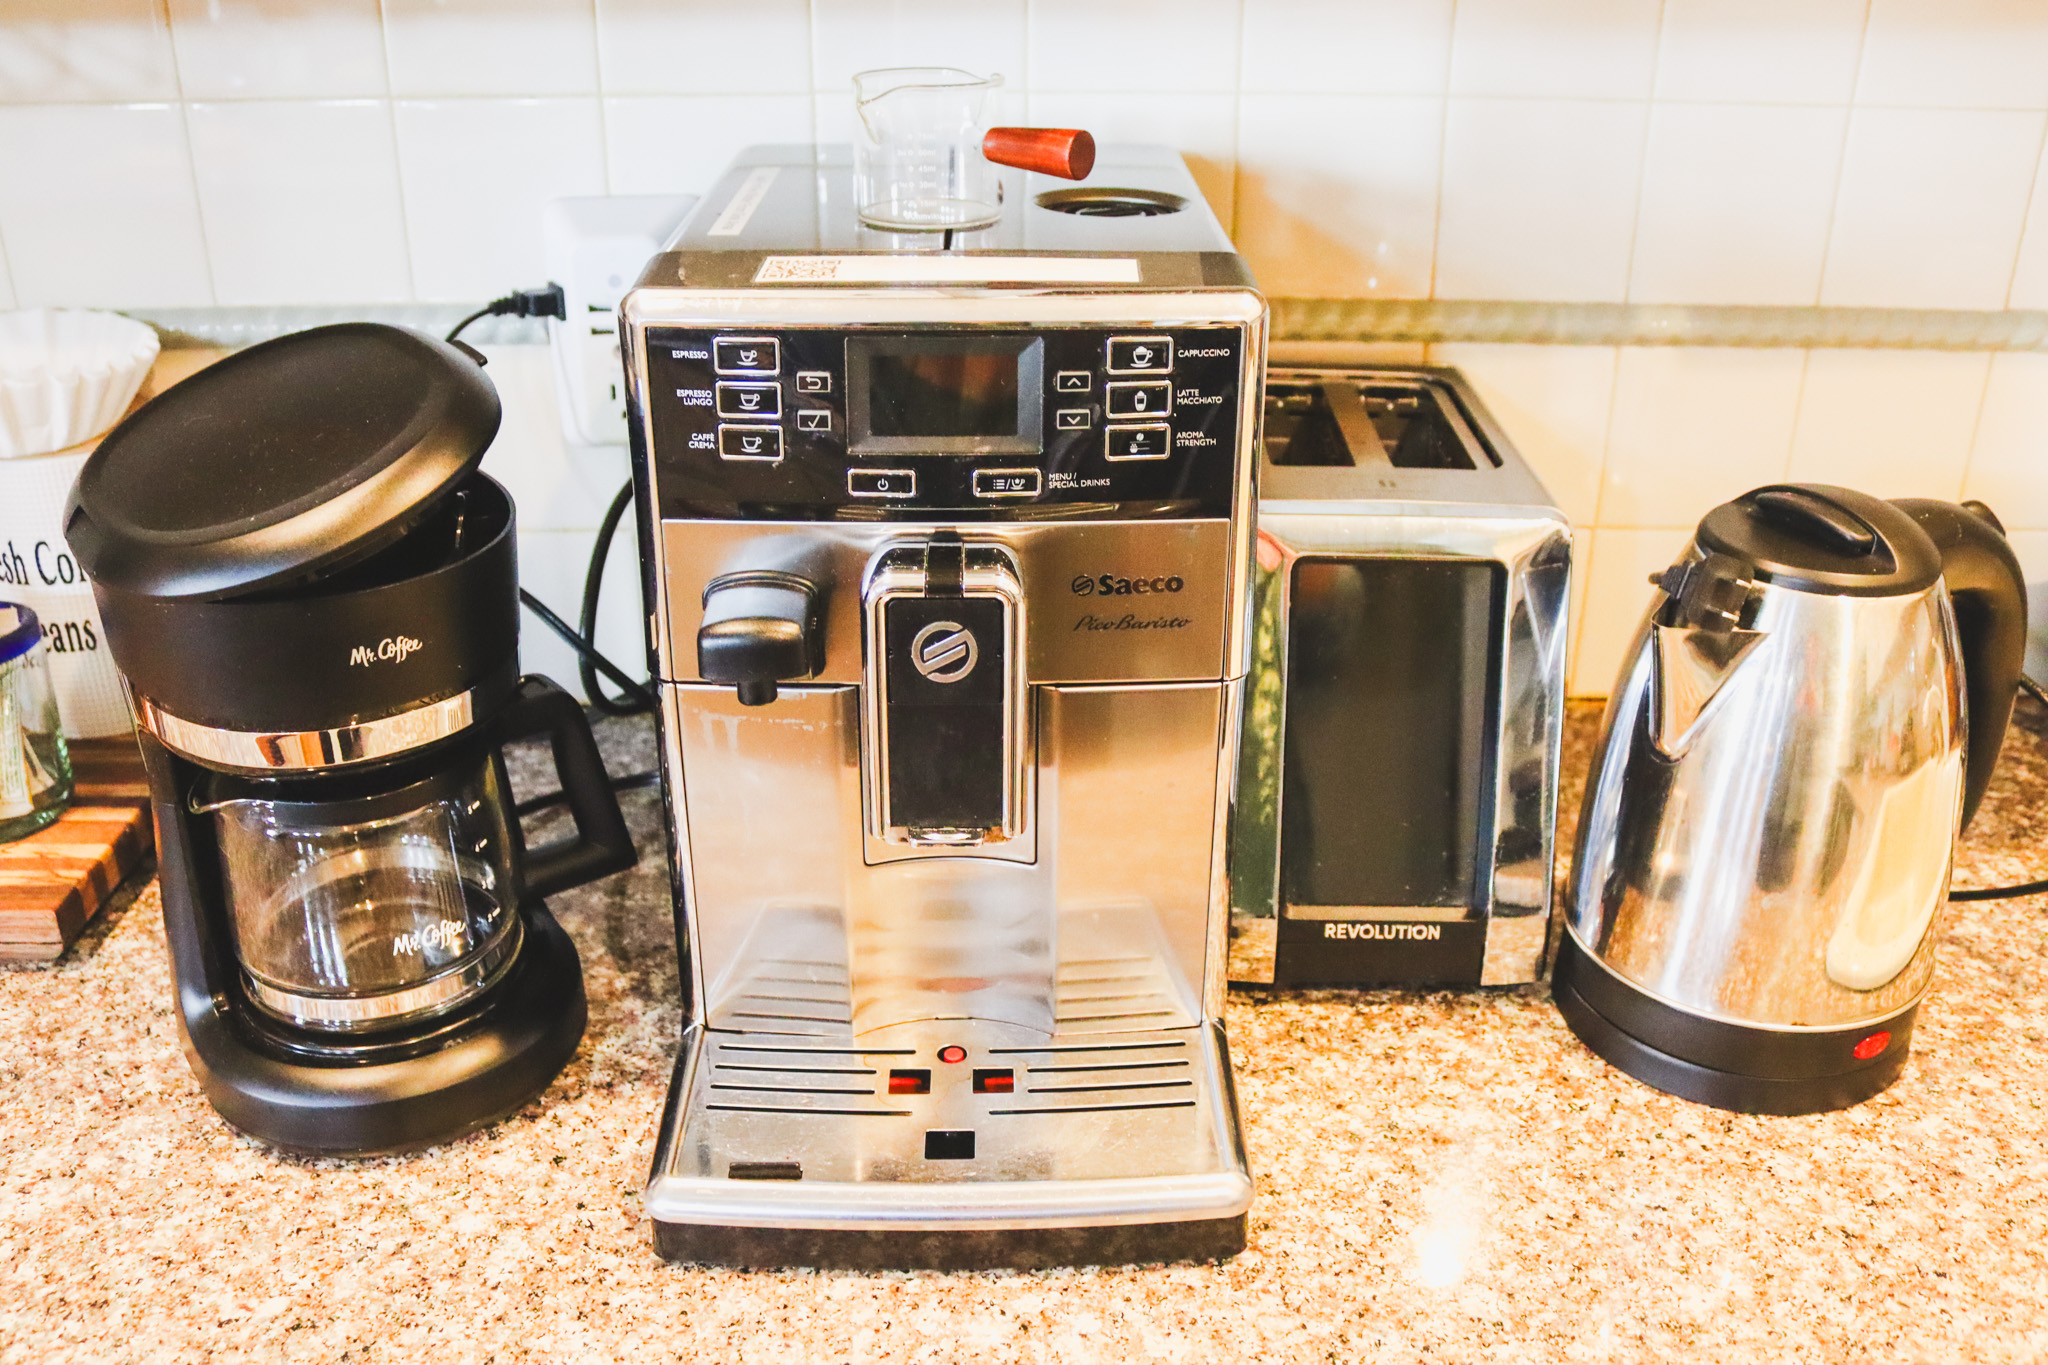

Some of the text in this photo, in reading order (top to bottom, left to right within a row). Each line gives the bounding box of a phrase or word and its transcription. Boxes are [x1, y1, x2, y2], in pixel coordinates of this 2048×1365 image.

[672, 350, 709, 359] ESPRESSO
[1178, 348, 1231, 358] CAPPUCCINO
[676, 389, 713, 398] ESPRESSO
[1176, 388, 1200, 397] LATTE
[683, 398, 714, 406] LUNGO
[1176, 396, 1223, 405] MACCHIATO
[1176, 431, 1205, 439] AROMA
[688, 441, 716, 449] CREMA
[1176, 438, 1217, 447] STRENGTH
[1048, 472, 1073, 481] MENU
[1048, 478, 1111, 489] SPECIAL DRINKS
[1098, 574, 1184, 596] Saeco
[350, 635, 423, 668] Mr. Coffee
[1324, 922, 1441, 940] REVOLUTION
[392, 919, 467, 957] Mr. Coffee
